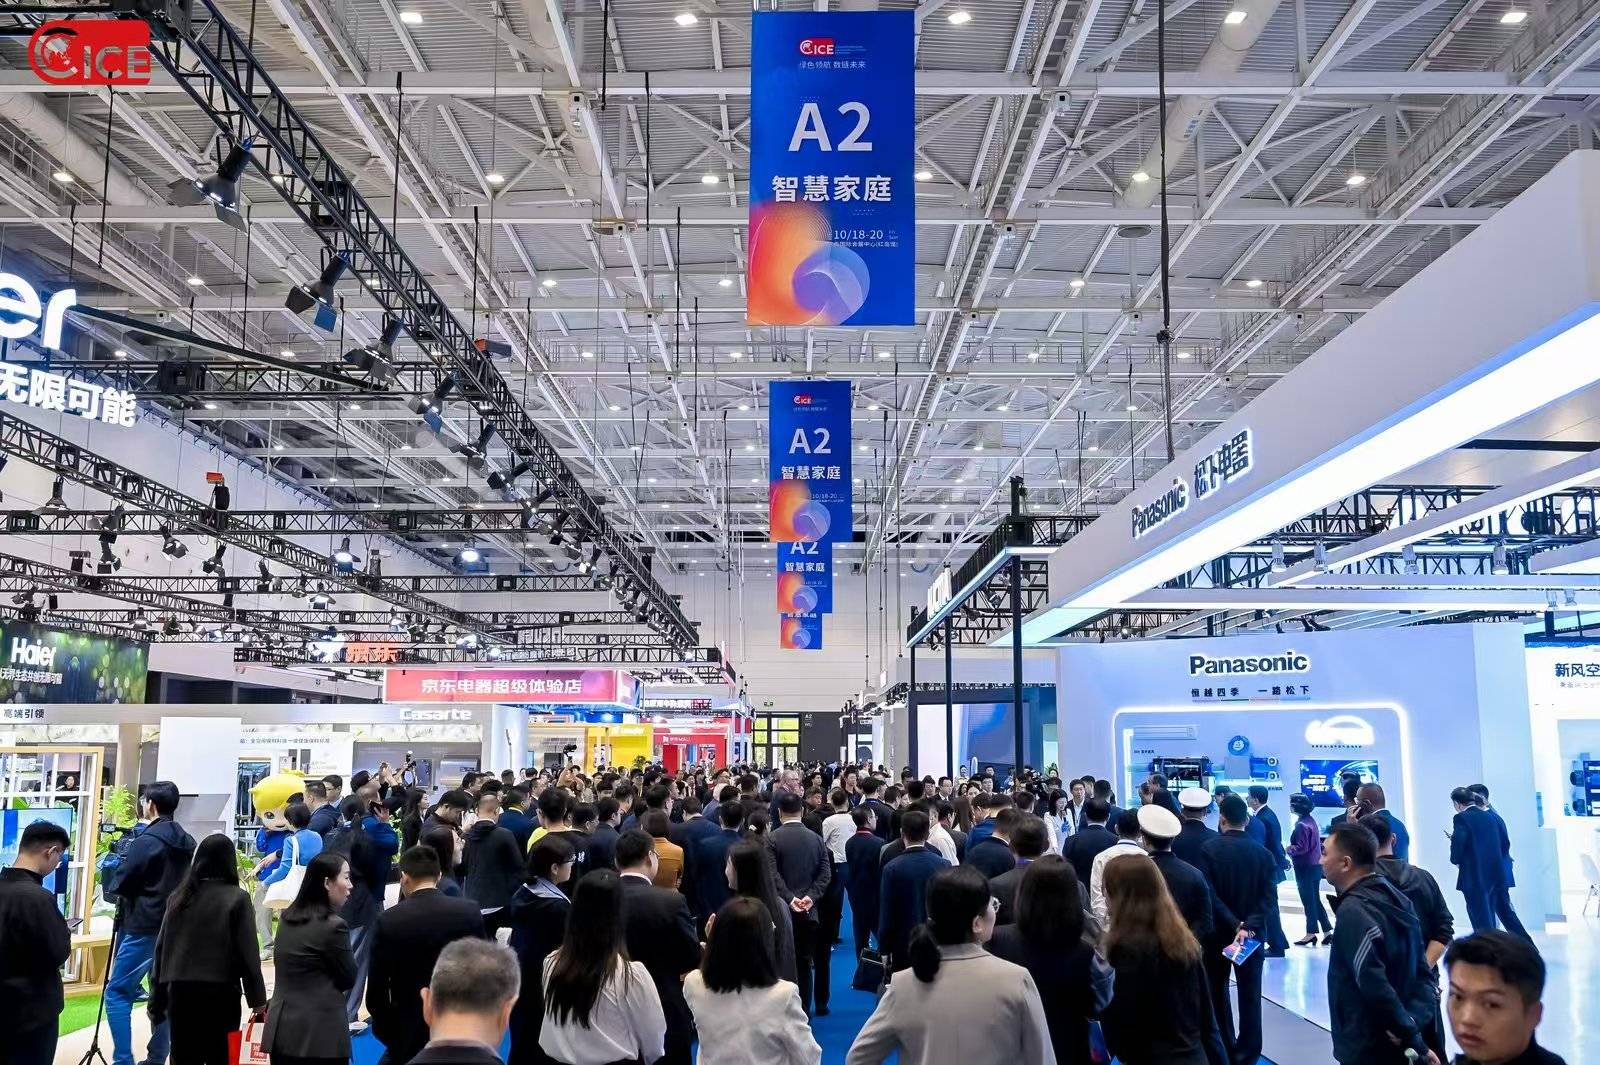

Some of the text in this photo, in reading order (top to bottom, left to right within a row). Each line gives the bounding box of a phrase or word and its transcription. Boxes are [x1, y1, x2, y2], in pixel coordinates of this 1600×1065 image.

[800, 40, 834, 54] CICE
[788, 101, 873, 152] A2
[772, 175, 892, 202] 智慧家庭
[834, 230, 884, 240] 10/18-20
[0, 361, 137, 427] 无限可能
[789, 428, 831, 453] A2
[1194, 429, 1250, 499] 松下电器
[781, 465, 841, 480] 智慧家庭
[1131, 478, 1187, 538] Panasonic
[790, 542, 819, 554] A2
[785, 562, 825, 572] 智慧家庭
[10, 637, 57, 667] Haier
[1189, 651, 1308, 675] Panasonic
[1555, 662, 1600, 678] 新风空
[421, 678, 582, 694] 京东电器超级体验店
[1258, 685, 1310, 696] 一路松下
[401, 708, 472, 721] Casarte
